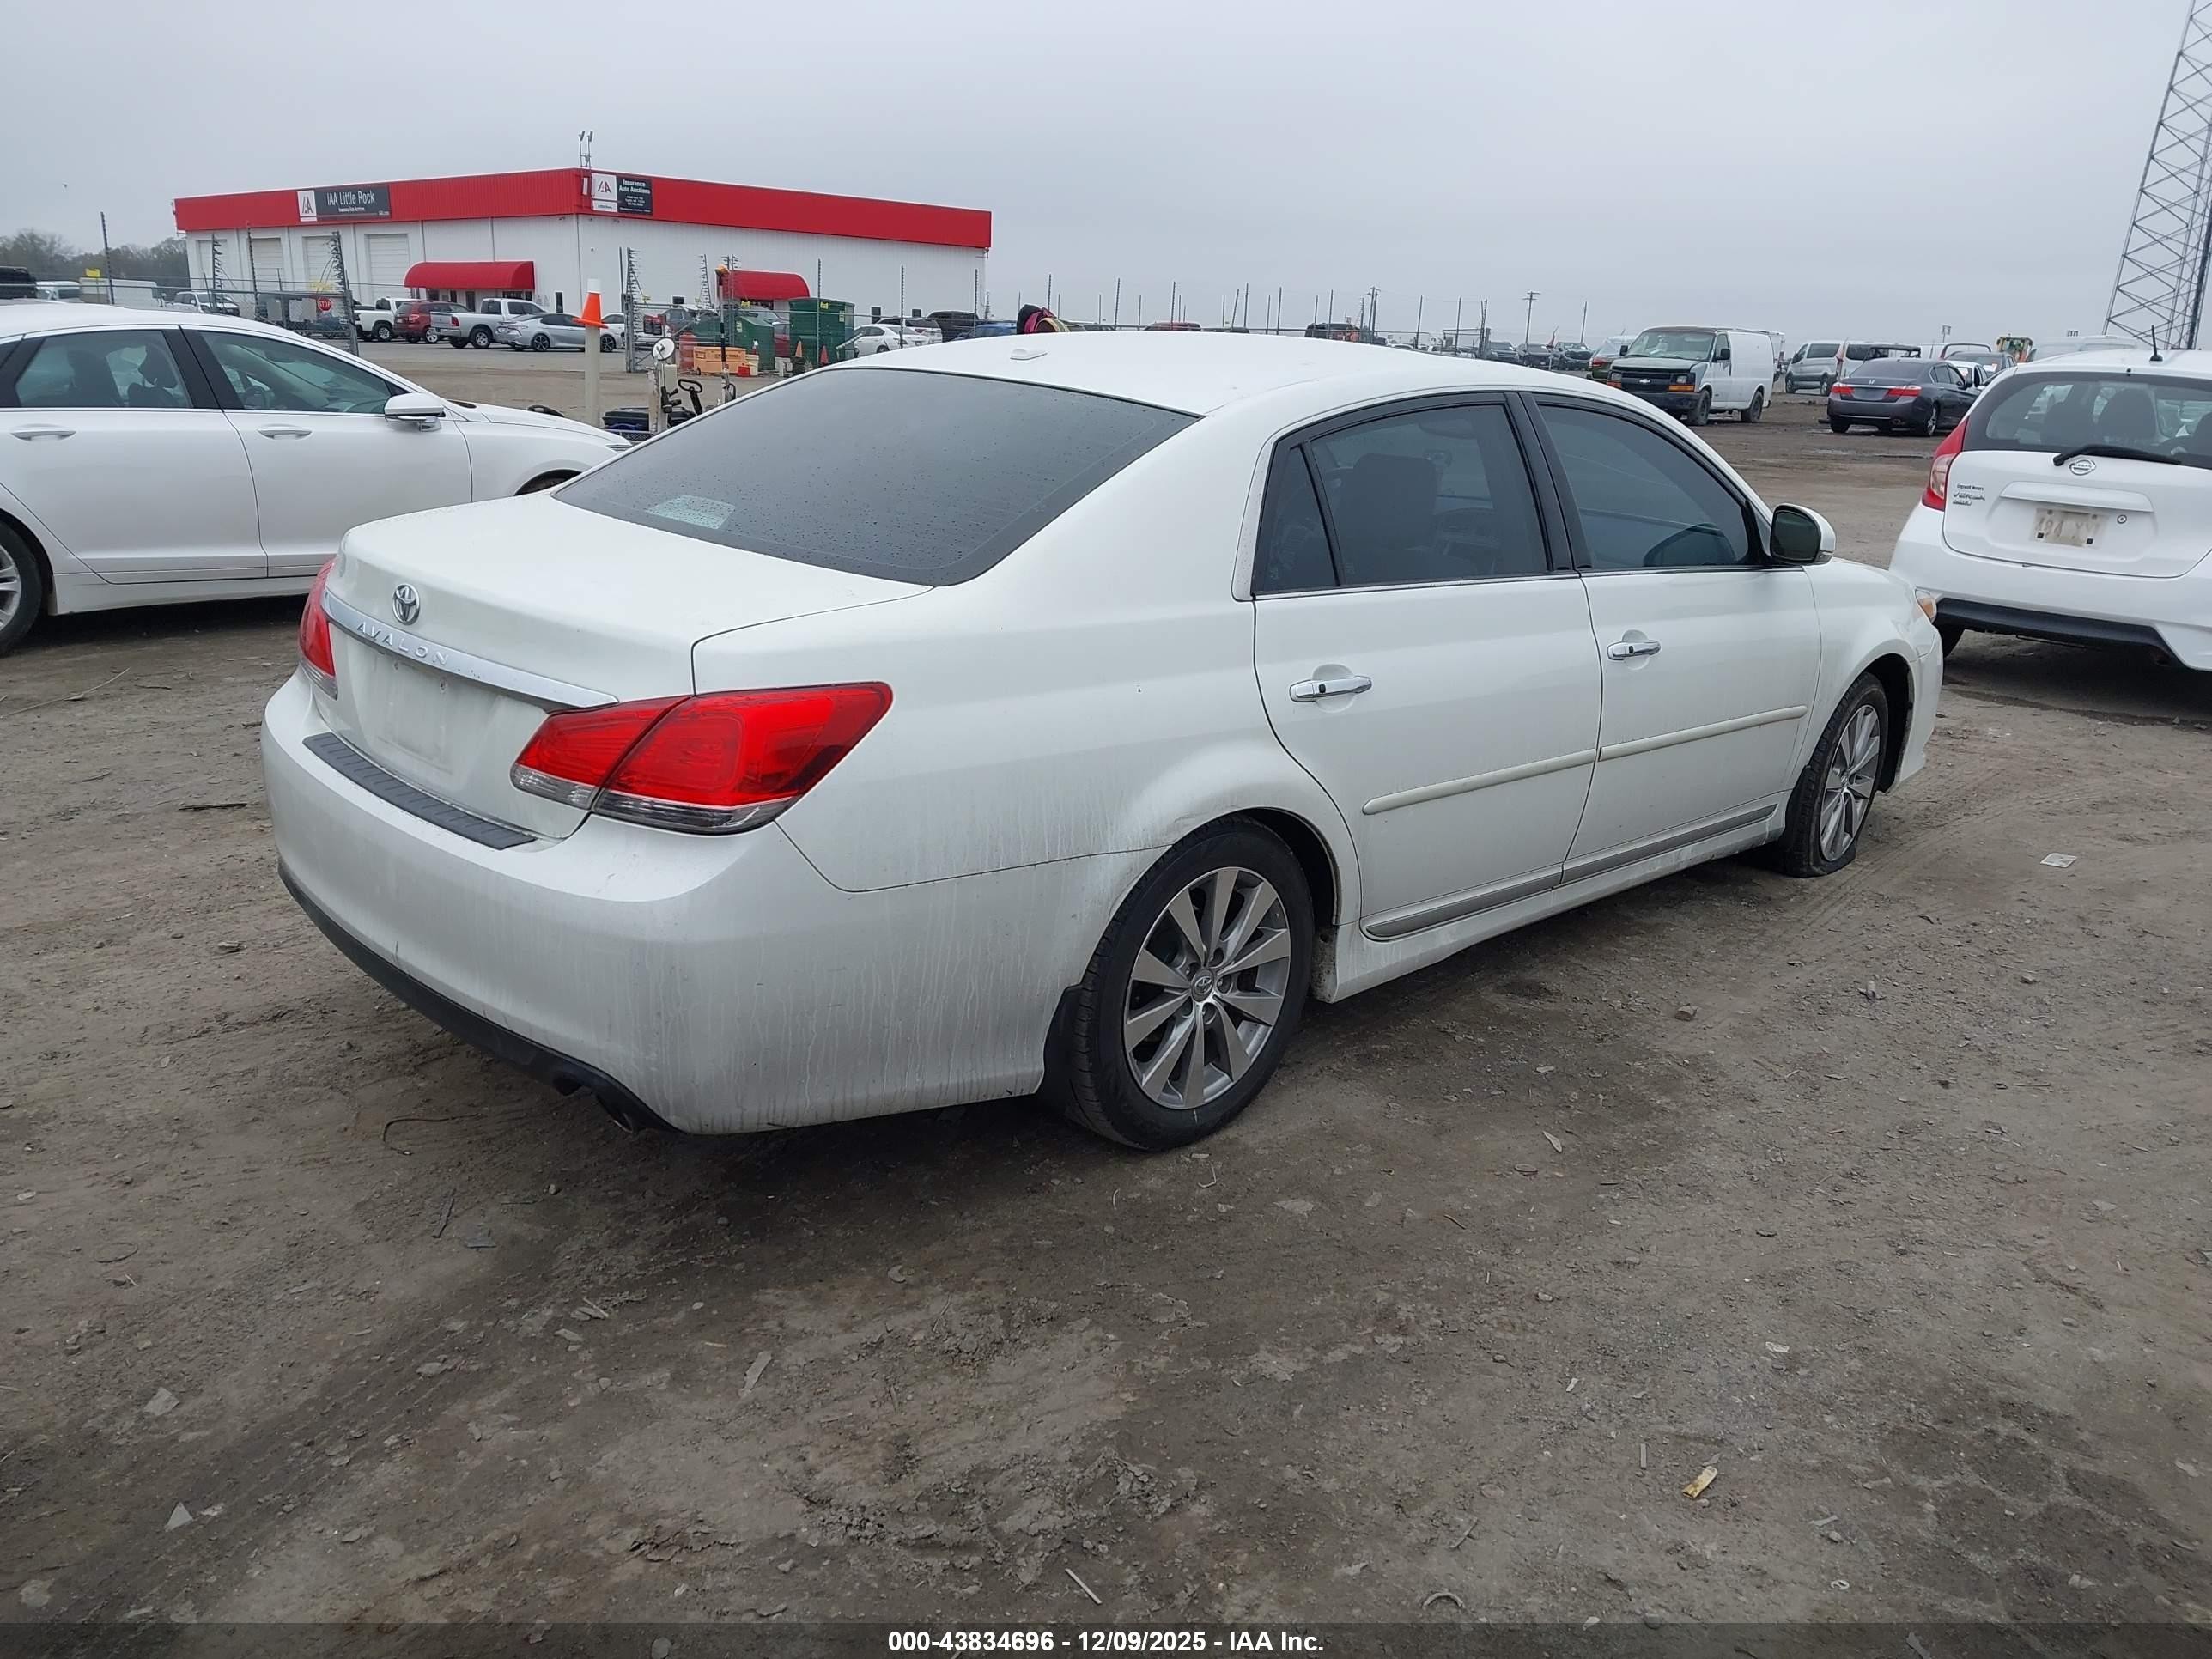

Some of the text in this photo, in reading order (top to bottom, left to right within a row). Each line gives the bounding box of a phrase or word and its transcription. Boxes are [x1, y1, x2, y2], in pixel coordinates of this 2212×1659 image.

[623, 179, 646, 187] Insurance
[327, 190, 375, 205] IAA Little Rock
[356, 621, 448, 665] AVALON
